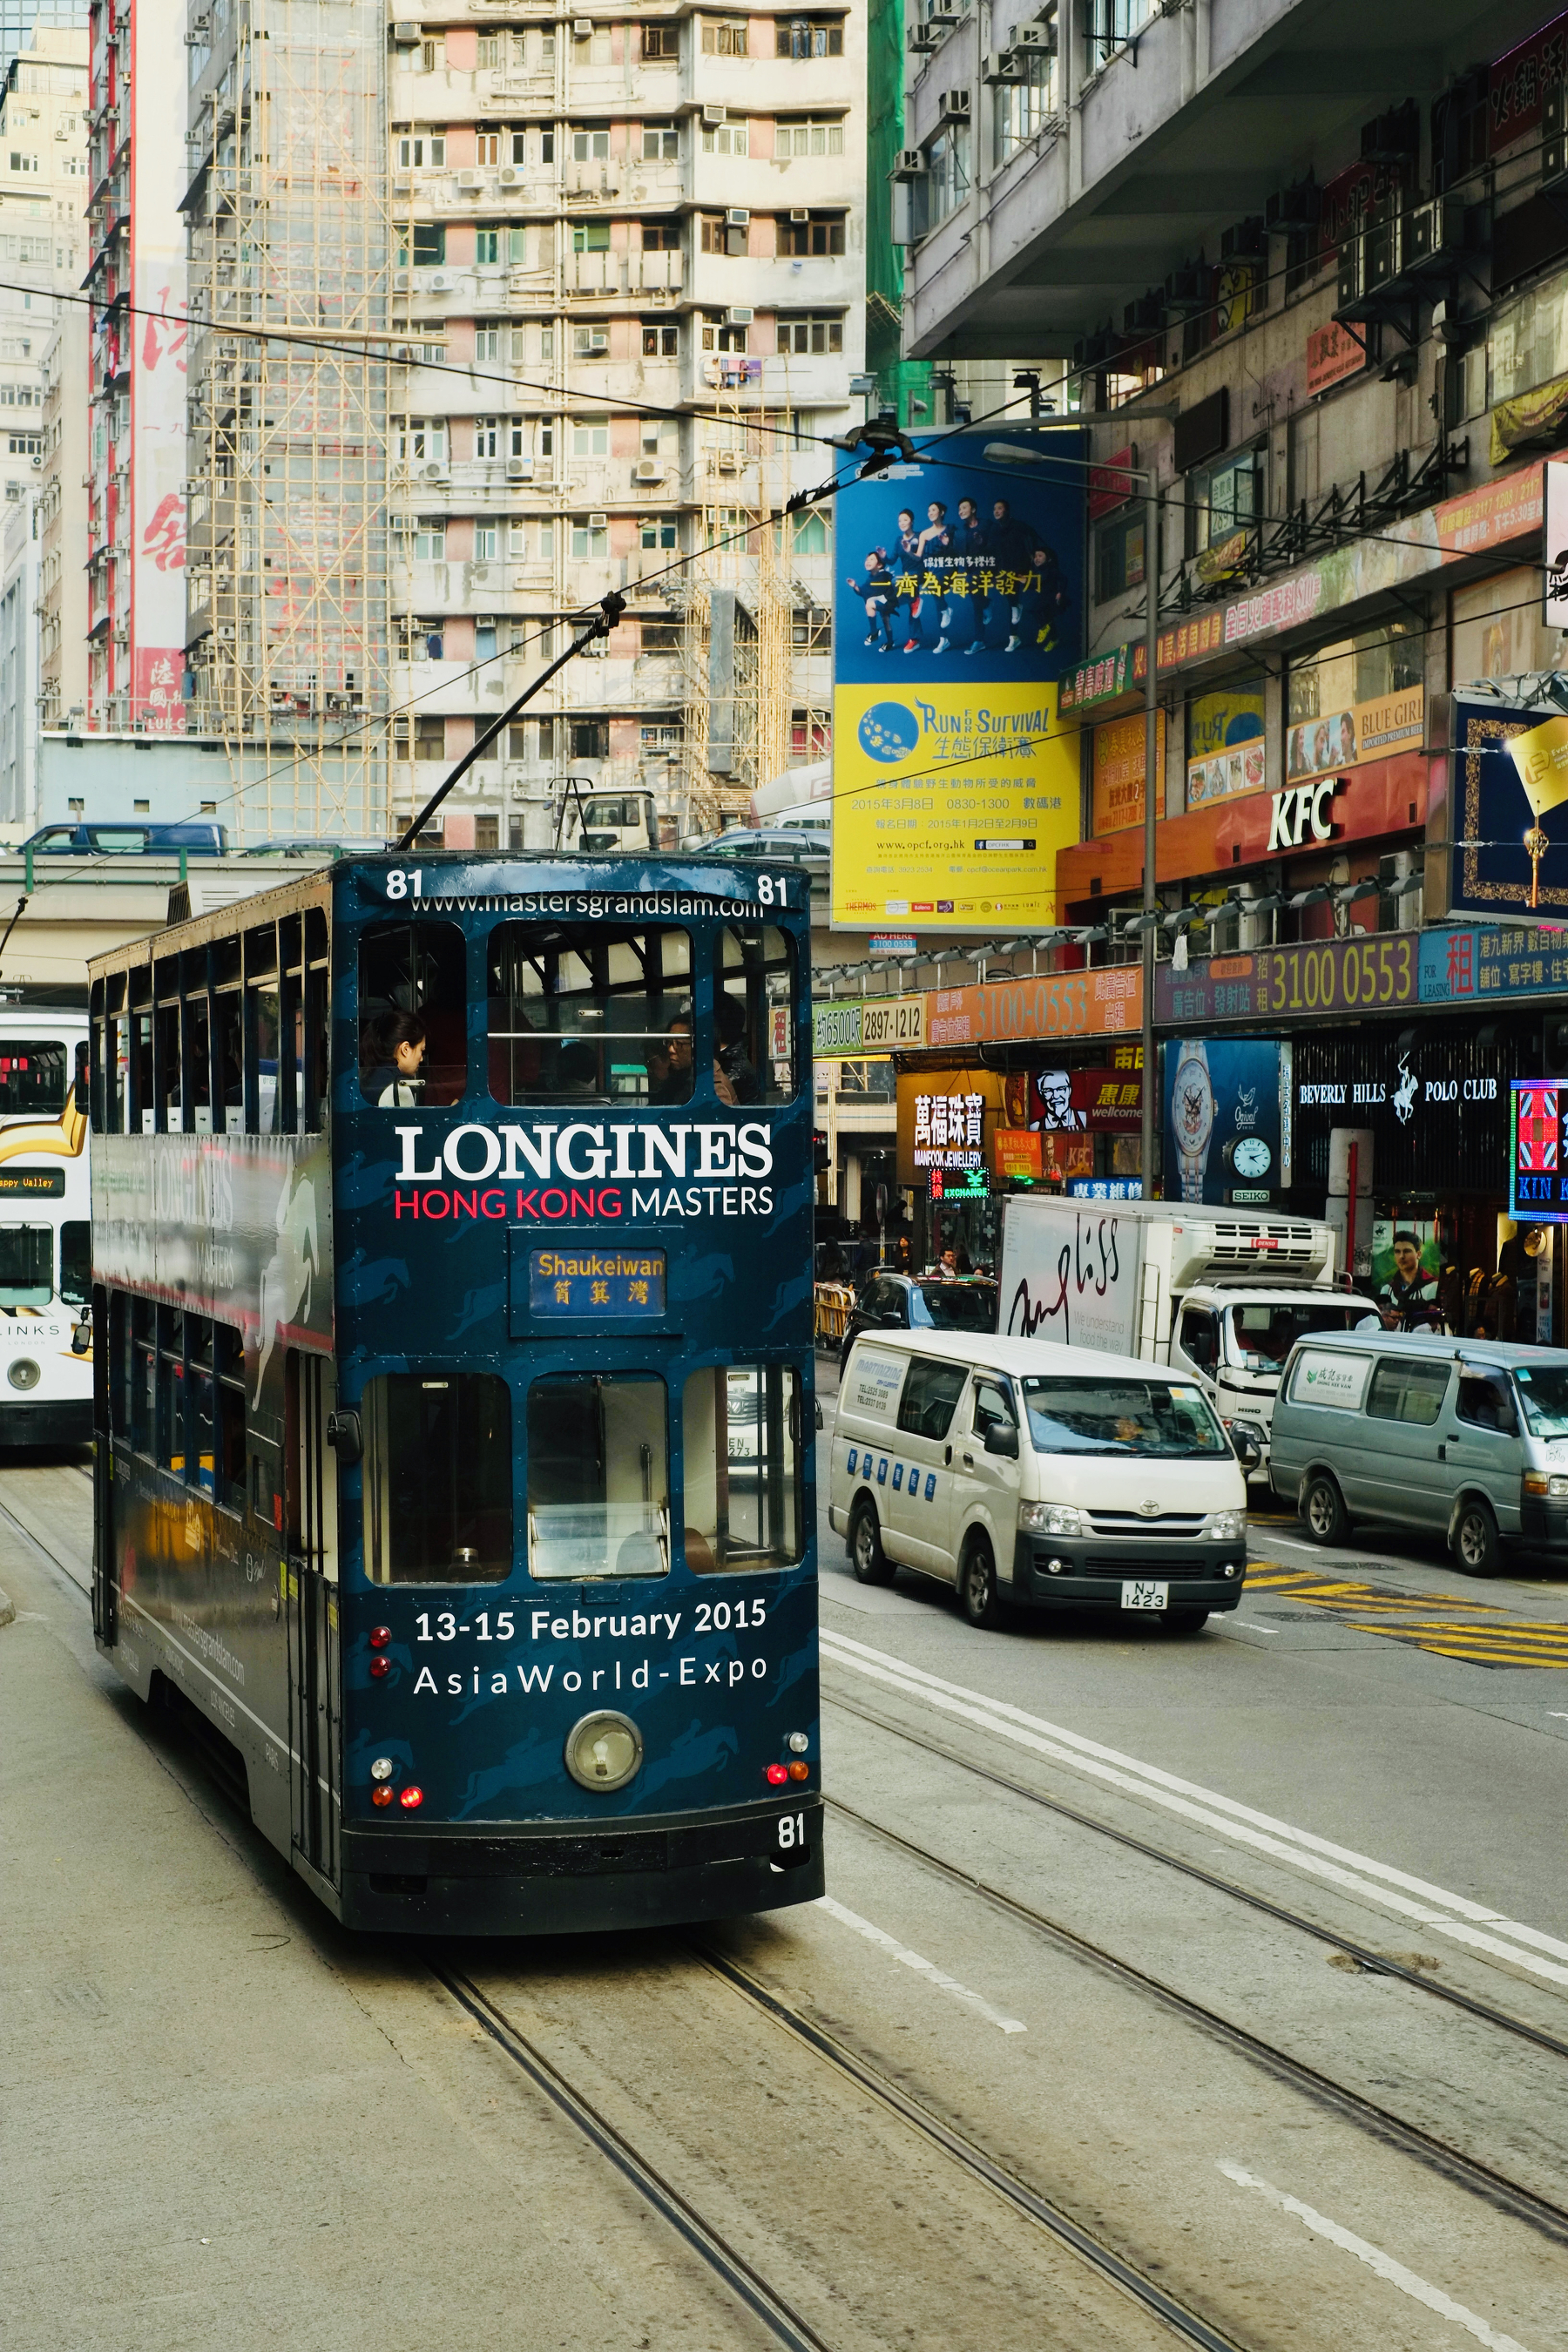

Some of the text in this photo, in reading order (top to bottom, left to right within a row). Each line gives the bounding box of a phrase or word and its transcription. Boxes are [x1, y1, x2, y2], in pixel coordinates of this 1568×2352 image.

[870, 571, 1041, 598] 一齊為海洋發力
[1075, 657, 1115, 705] 青島啤酒
[916, 700, 961, 733] RUN
[964, 709, 973, 733] FOR
[1362, 698, 1423, 736] BLUE GIRL
[932, 735, 1037, 760] 生態保衛賽
[1362, 725, 1423, 749] IMPORTED PREMIUM BEER
[851, 796, 1062, 810] 2015年3月8日 0830-1300 數碼港
[1267, 779, 1335, 851] KFC
[876, 841, 965, 851] www.opcf.org.hk
[966, 866, 1048, 875] opcf@oceanpark.com.hk
[386, 870, 423, 900] 81
[757, 875, 787, 906] 81
[409, 892, 765, 918] www.mastersgrandslam.com
[845, 902, 876, 912] THERMOS
[1480, 931, 1524, 958] 港九新界
[1272, 939, 1412, 1010] 3100 0553
[1424, 964, 1436, 979] FOR
[1447, 934, 1474, 996] 租
[1095, 970, 1136, 1001] 此廣告位
[1424, 983, 1450, 997] LEASING
[976, 981, 1086, 1037] 3100-0553
[1105, 1002, 1125, 1030] 出租
[816, 1006, 862, 1051] 約6500呎
[931, 1016, 970, 1043] 廣告位招租
[1096, 1084, 1140, 1105] 惠康
[1300, 1078, 1497, 1105] BEVERLY HILLS POLO CLUB
[915, 1092, 983, 1146] 萬福珠寶
[1092, 1107, 1143, 1119] wellcome
[395, 1124, 774, 1180] LONGINES
[915, 1150, 983, 1167] MANFOOK JEWELLERY
[1069, 1147, 1091, 1166] KFC
[23, 1178, 54, 1188] Valley
[149, 1147, 233, 1233] LONGINES
[944, 1188, 988, 1198] EXCHANGE
[1072, 1182, 1143, 1200] 專業維修
[1518, 1177, 1551, 1200] KIN
[395, 1186, 774, 1220] HONG KONG MASTERS
[1233, 1192, 1268, 1200] SEIKO
[539, 1254, 664, 1278] Shaukeiwan
[553, 1281, 649, 1306] 筲箕灣
[1074, 1311, 1125, 1335] We understand
[1079, 1328, 1124, 1353] food the way
[855, 1359, 903, 1381] MARTINIZING
[728, 1438, 744, 1447] EN
[1125, 1594, 1165, 1608] 1423
[1135, 1583, 1156, 1596] NJ
[416, 1598, 767, 1641] 13-15 February 2015
[170, 1602, 245, 1686] www.mastersgrandslam.com
[413, 1657, 768, 1694] AsiaWorld-Expo
[778, 1813, 805, 1848] 81
